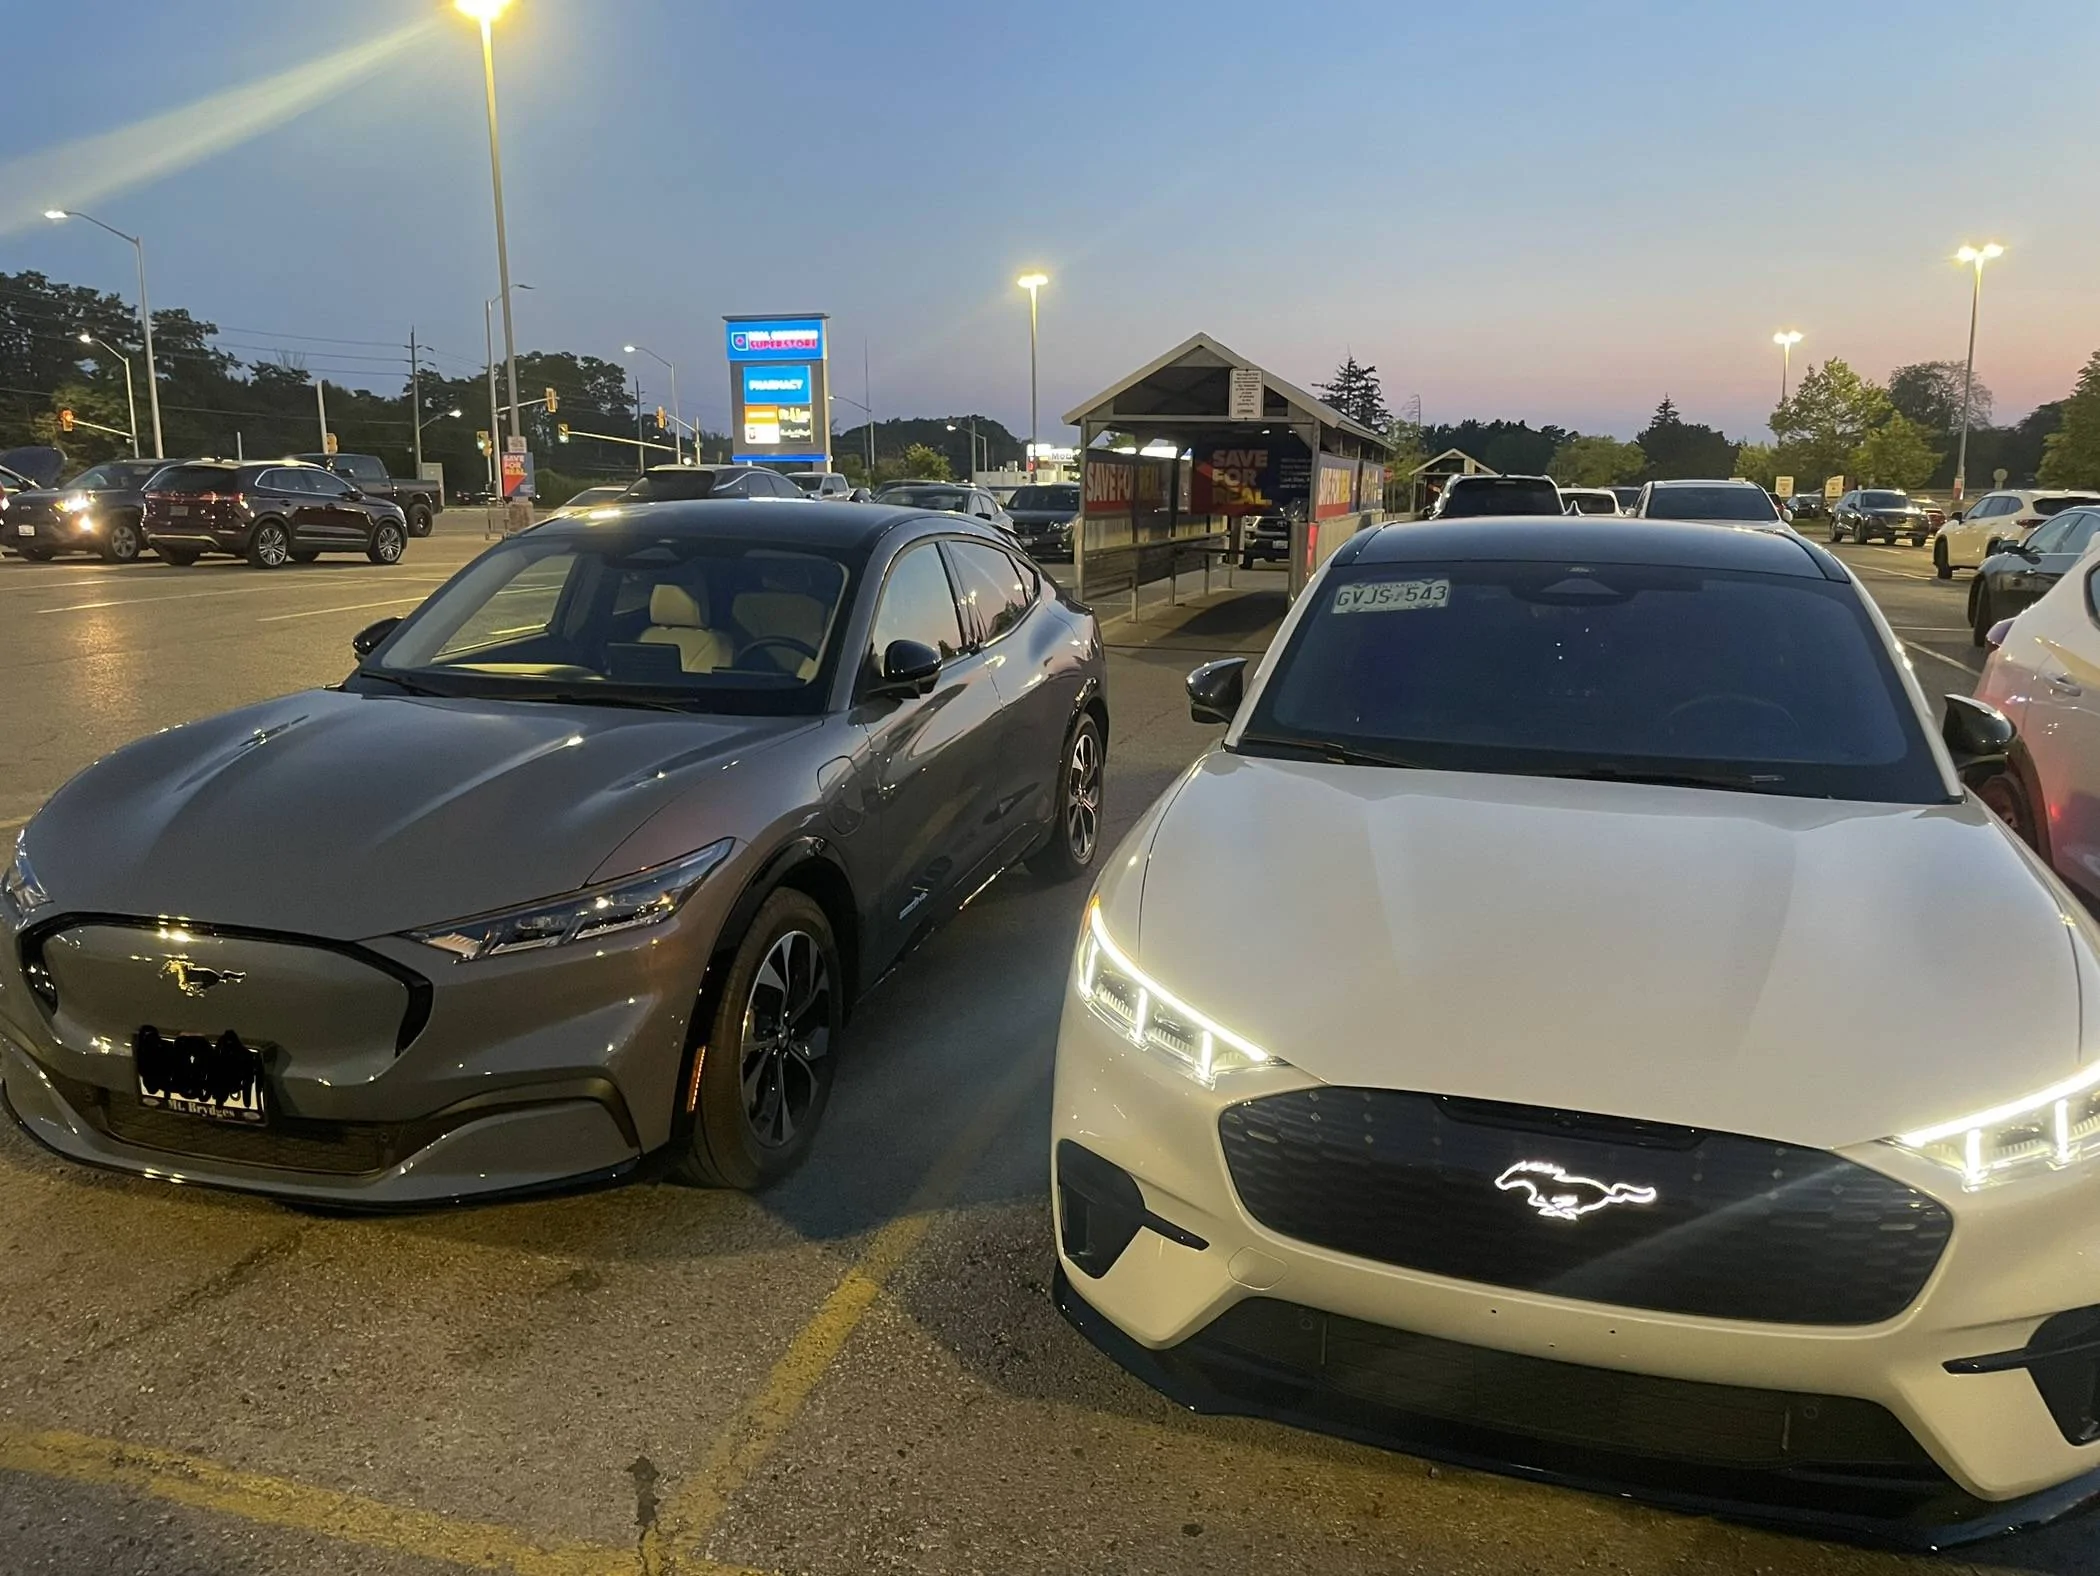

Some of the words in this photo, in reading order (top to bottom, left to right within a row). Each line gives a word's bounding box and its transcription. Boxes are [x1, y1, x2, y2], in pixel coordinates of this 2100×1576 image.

[1212, 448, 1269, 468] SAVE
[1086, 462, 1116, 502] SAVE
[1212, 467, 1257, 487] FOR
[1212, 485, 1273, 506] REAL
[1337, 588, 1392, 607] GVJS
[1405, 585, 1447, 603] 543
[168, 1099, 186, 1112] Mt.
[188, 1102, 235, 1118] Brydges
